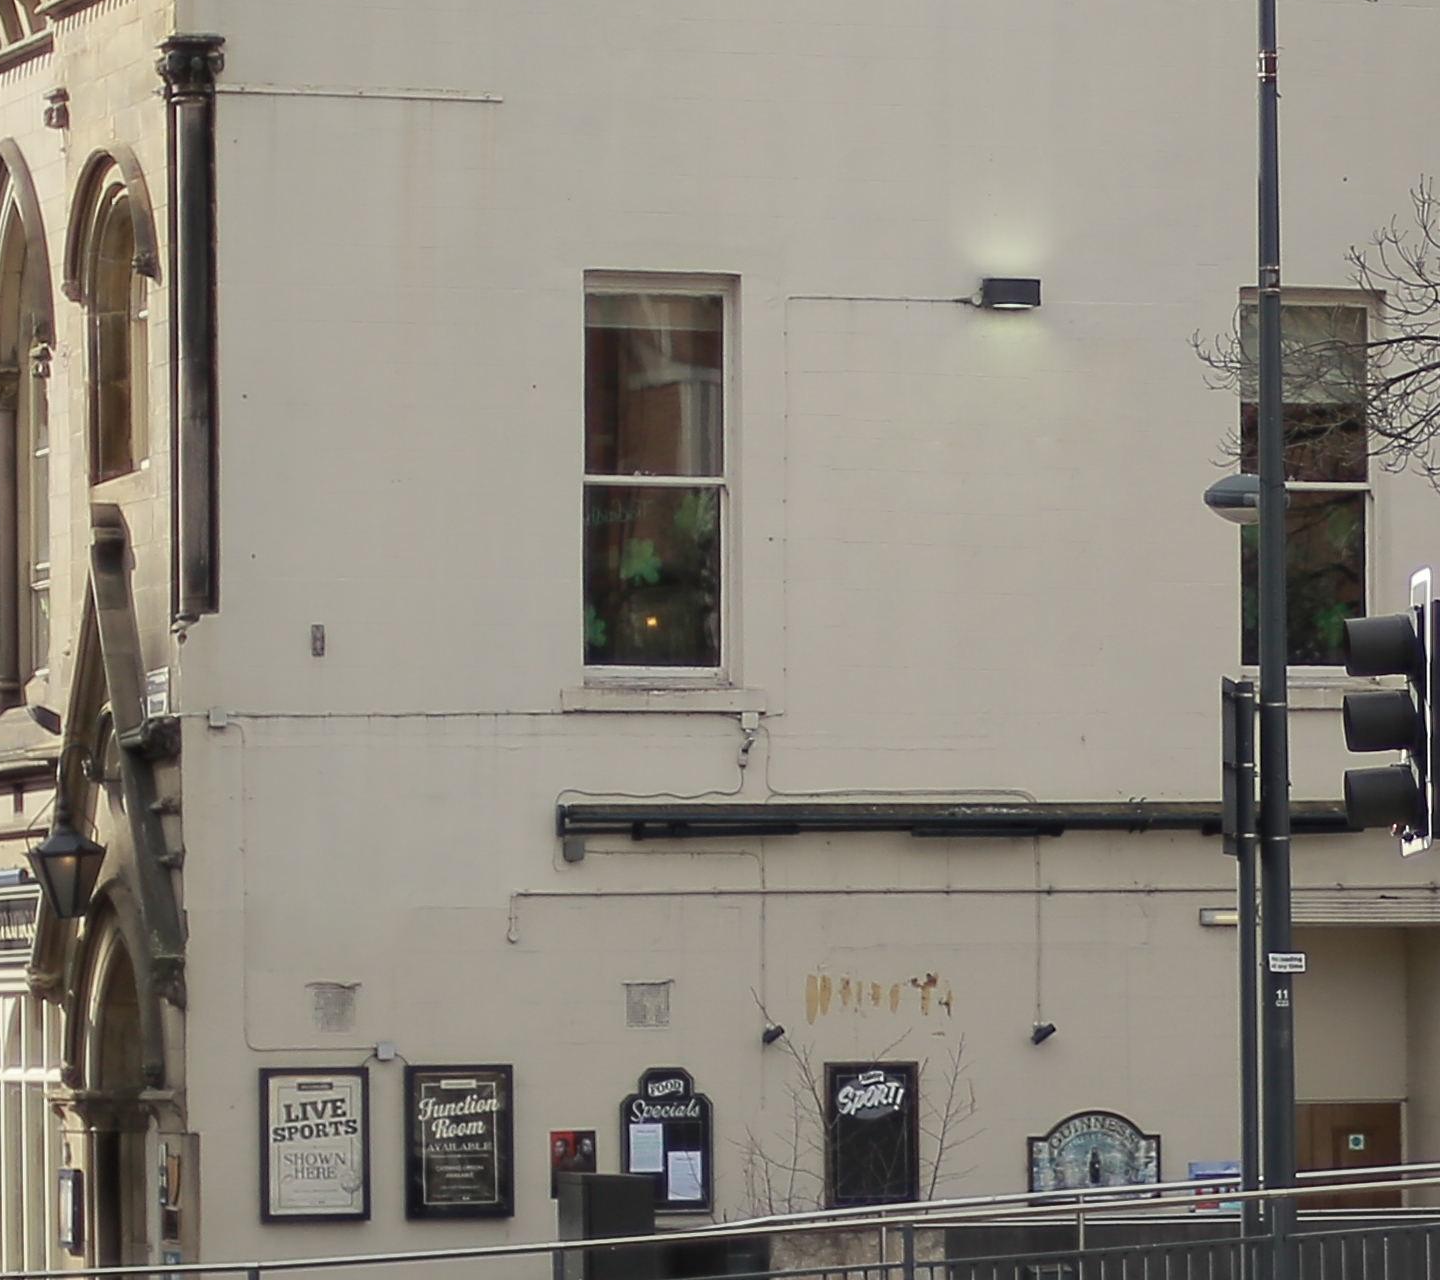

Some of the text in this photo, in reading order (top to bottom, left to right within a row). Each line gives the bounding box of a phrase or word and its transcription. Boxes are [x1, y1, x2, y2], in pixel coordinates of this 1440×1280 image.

[1276, 989, 1288, 999] 11
[649, 1080, 682, 1096] FOOD
[838, 1081, 905, 1116] SPORT!
[284, 1098, 348, 1123] LIVE
[418, 1094, 501, 1121] Function
[630, 1098, 701, 1123] Specials
[272, 1119, 359, 1144] SPORTS
[431, 1118, 487, 1140] Room
[1049, 1115, 1138, 1150] GUINNESS
[427, 1141, 493, 1153] AVAILABLE
[283, 1152, 347, 1167] SHOWN
[293, 1166, 339, 1181] HERE
